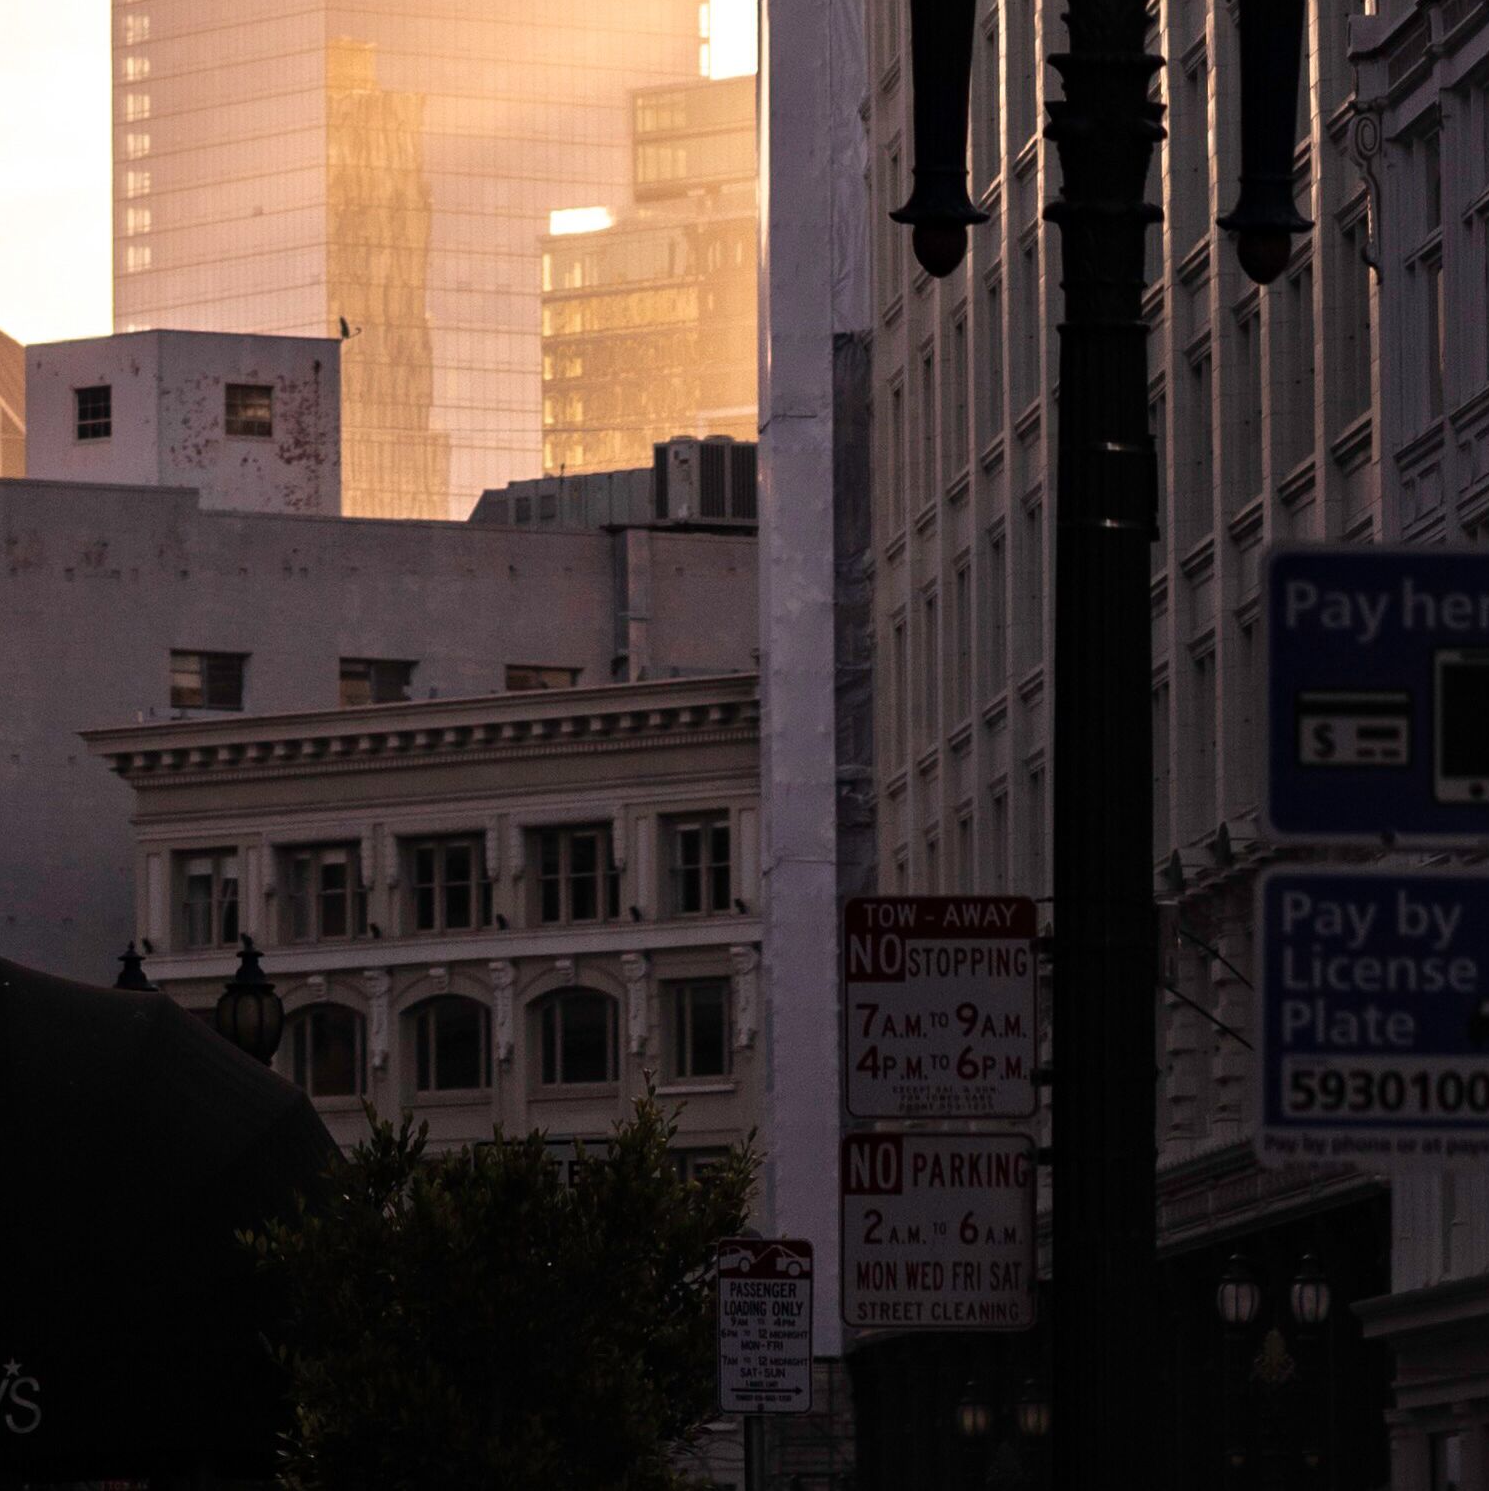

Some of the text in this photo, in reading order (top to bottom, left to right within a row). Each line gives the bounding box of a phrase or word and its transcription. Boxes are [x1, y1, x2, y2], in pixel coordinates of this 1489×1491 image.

[1283, 578, 1390, 644] Pay
[1280, 887, 1462, 950] Pay by
[849, 933, 1027, 977] NO STOPPING
[1281, 942, 1479, 993] License
[929, 1011, 949, 1028] TO
[1280, 997, 1416, 1046] Plate
[929, 1054, 950, 1071] TO
[849, 1141, 1028, 1190] NO PARKING
[932, 1221, 946, 1236] TO
[857, 1261, 1021, 1291] MON WED FRI SAT
[730, 1282, 797, 1298] PASSENGER
[724, 1300, 803, 1317] LOADING ONLY
[857, 1301, 1019, 1321] STREET CLEANING
[758, 1328, 768, 1339] 12
[770, 1330, 808, 1339] MIDNIGHT
[770, 1358, 808, 1367] MIDNIGHT
